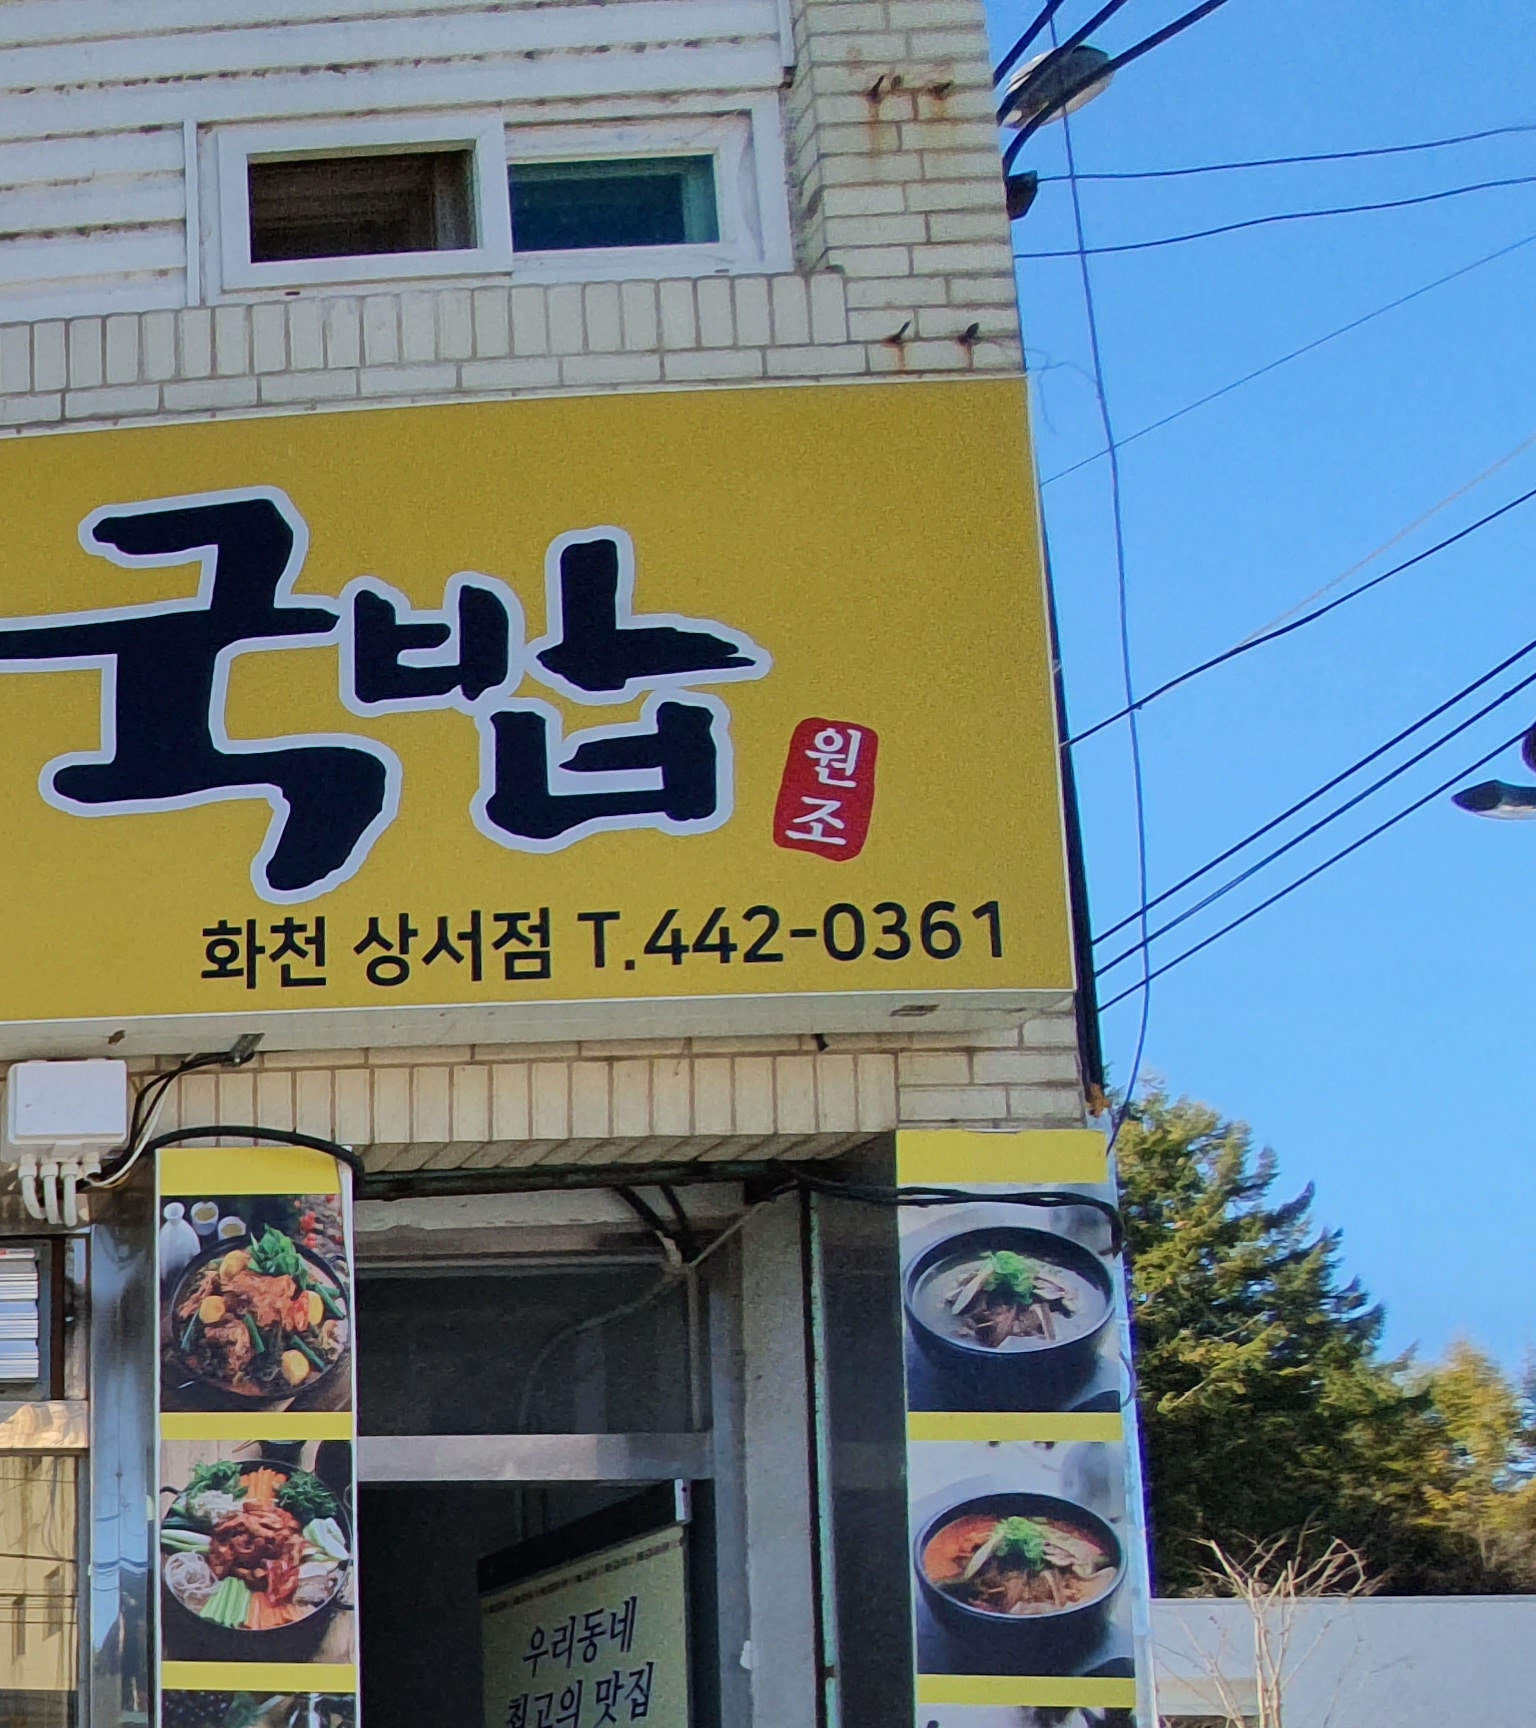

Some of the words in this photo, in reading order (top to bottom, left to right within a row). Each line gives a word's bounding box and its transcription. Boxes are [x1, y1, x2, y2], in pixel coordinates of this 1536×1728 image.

[785, 726, 866, 848] 원조
[201, 915, 329, 988] 화천
[353, 906, 553, 986] 상서점
[577, 901, 1006, 972] T.442-0361
[522, 1595, 639, 1678] 우리동네
